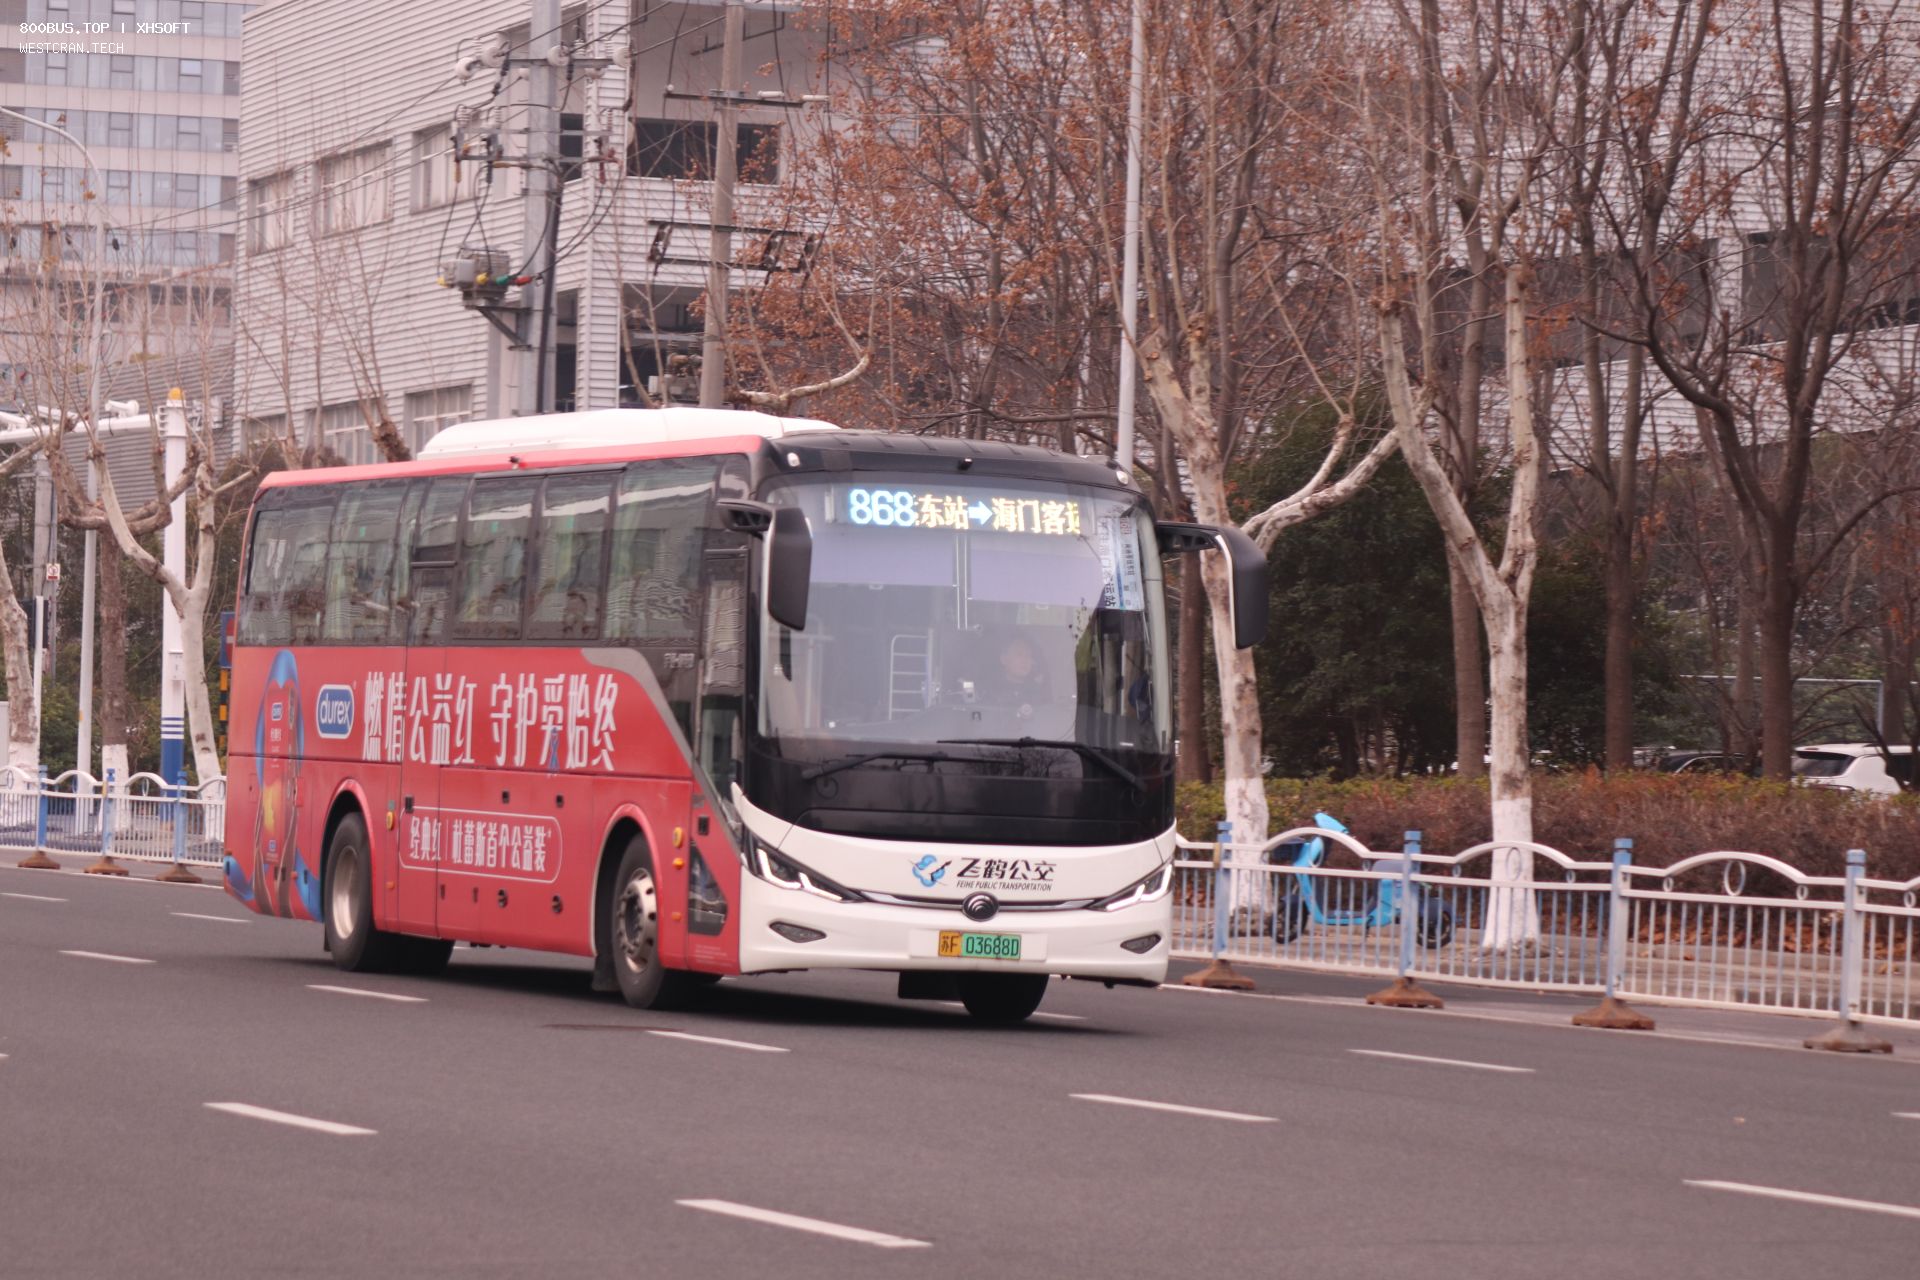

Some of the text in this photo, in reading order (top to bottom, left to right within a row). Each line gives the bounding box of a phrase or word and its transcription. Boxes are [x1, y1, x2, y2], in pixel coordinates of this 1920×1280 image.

[849, 488, 915, 527] 868
[319, 692, 351, 725] durex
[362, 671, 477, 765] 燃情公益红
[409, 815, 443, 862] 经典红
[956, 856, 1057, 882] 飞鹤公交
[975, 881, 998, 890] PUBLIC
[998, 881, 1053, 892] TRANSPORTATION
[965, 935, 1020, 957] 03688D
